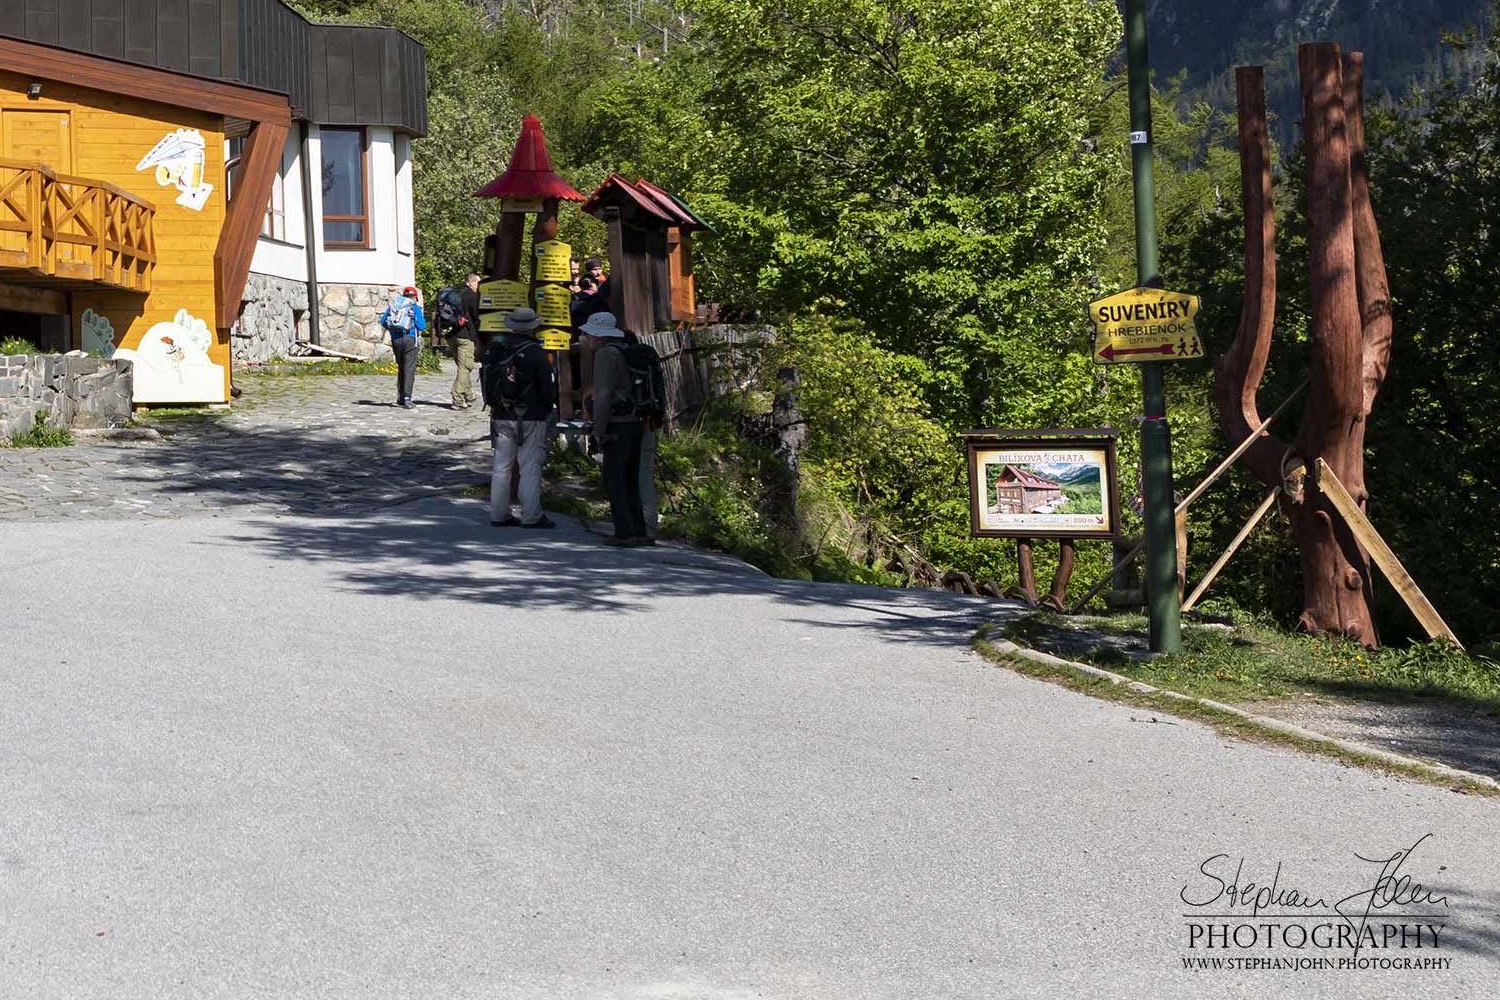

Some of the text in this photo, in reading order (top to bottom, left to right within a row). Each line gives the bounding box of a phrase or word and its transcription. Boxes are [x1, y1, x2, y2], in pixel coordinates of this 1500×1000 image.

[1098, 296, 1190, 323] SUVENÍRY
[1108, 323, 1188, 337] HREBIENOK
[1051, 453, 1085, 462] CHATA
[1073, 516, 1087, 524] 200
